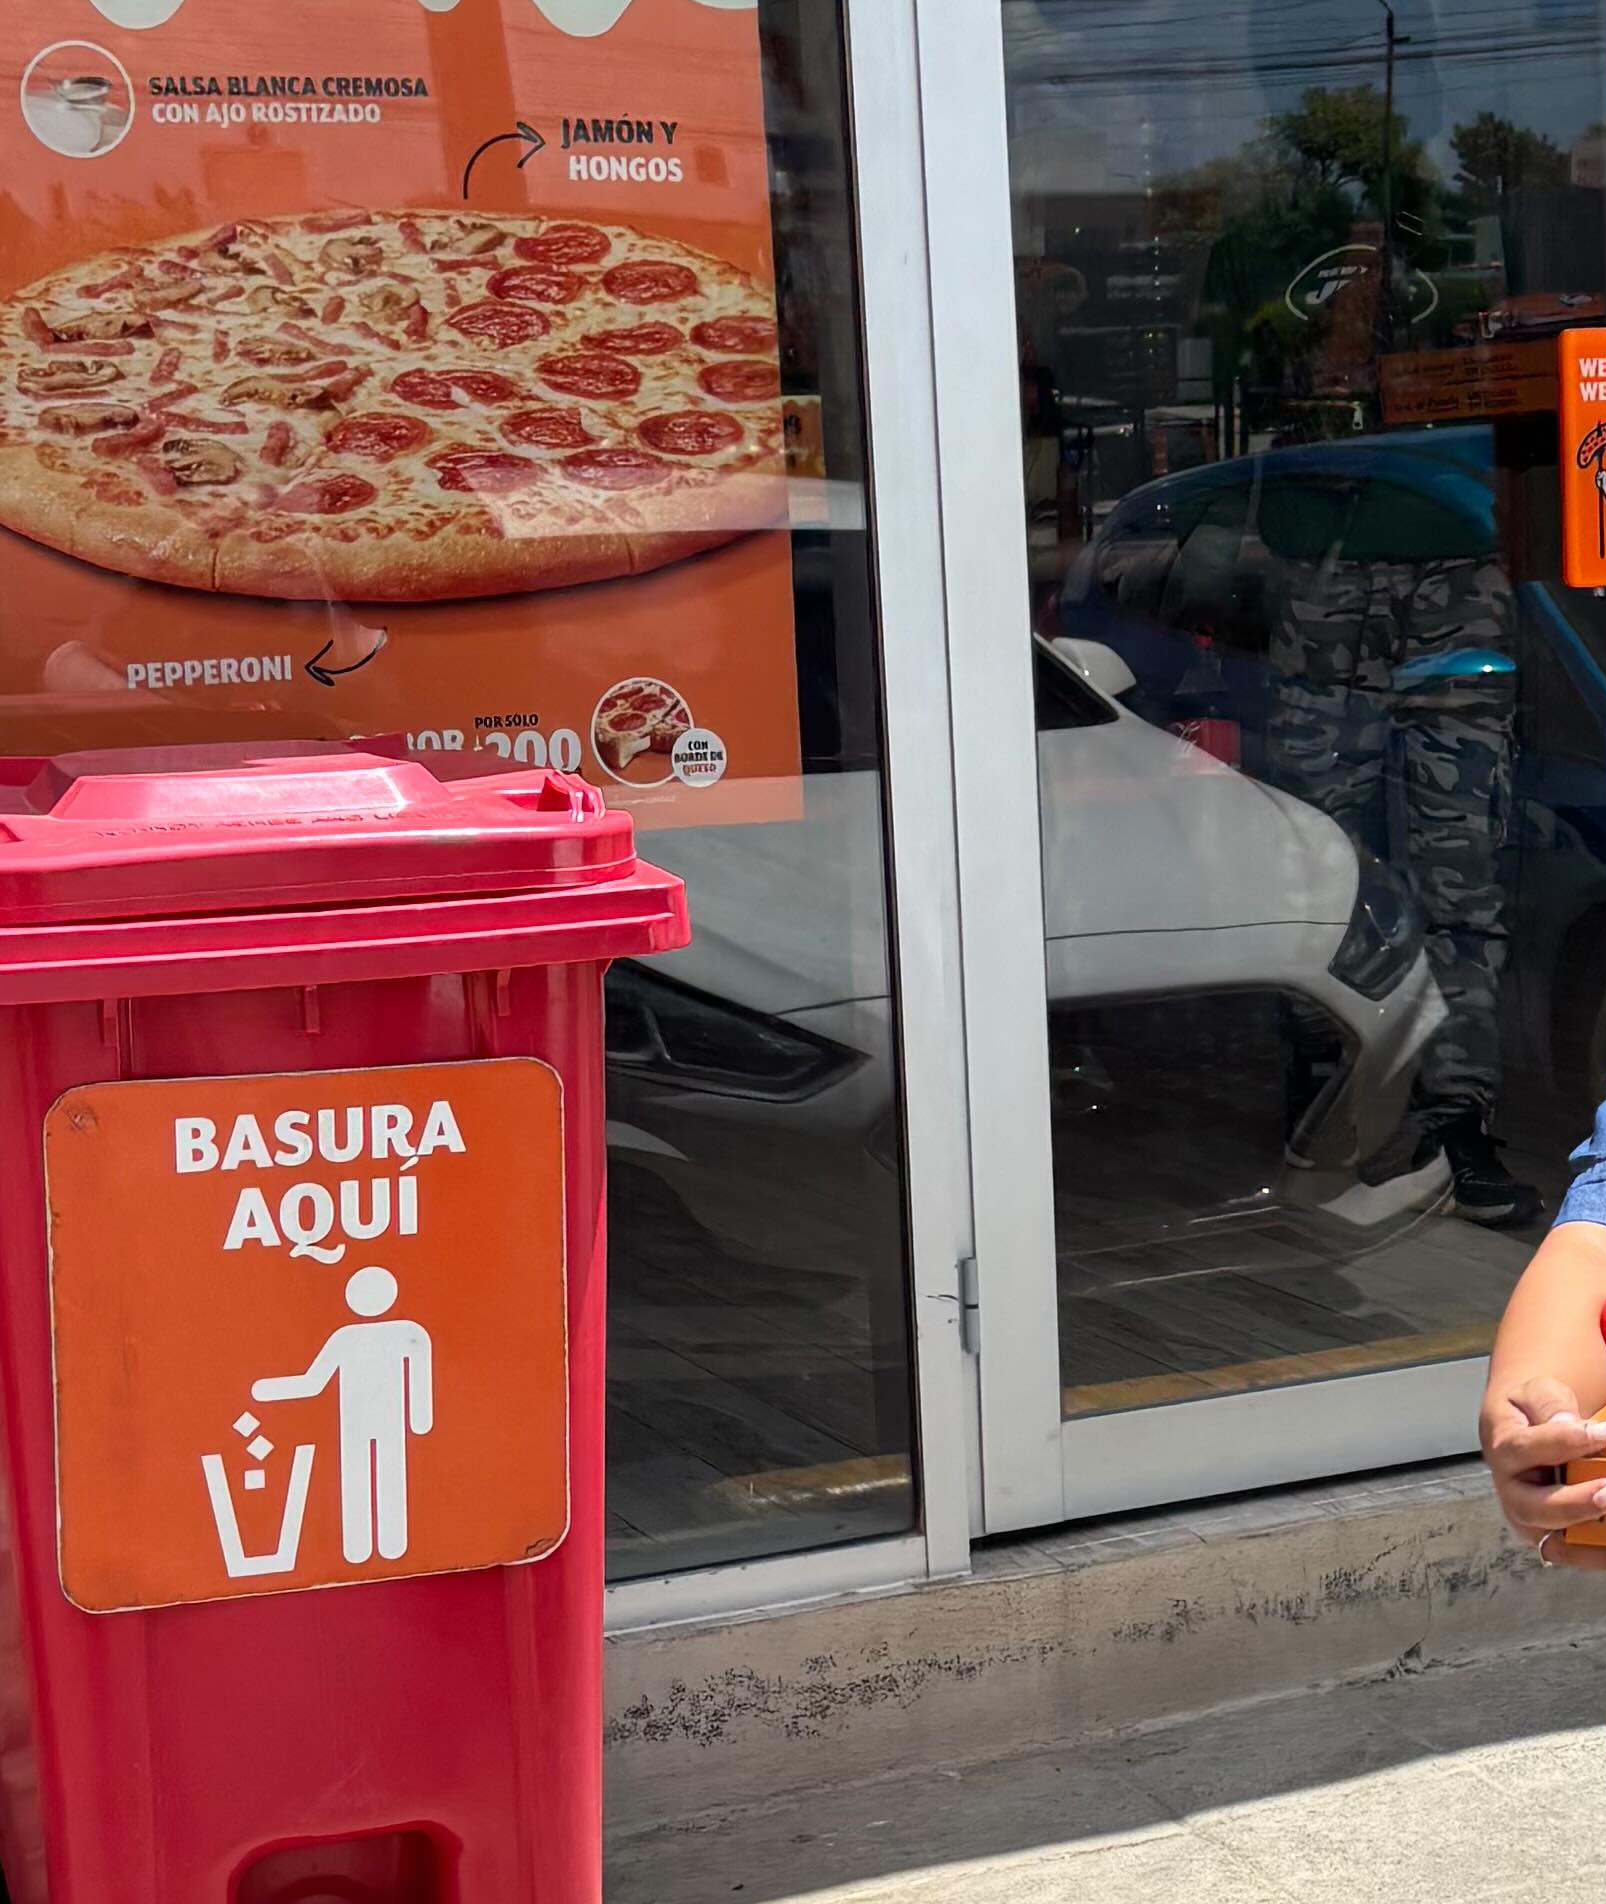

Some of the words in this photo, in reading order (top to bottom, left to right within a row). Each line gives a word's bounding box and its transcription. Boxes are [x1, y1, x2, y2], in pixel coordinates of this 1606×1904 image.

[149, 76, 221, 96] SALSA
[227, 77, 317, 97] BLANCA
[322, 77, 429, 98] CREMOSA
[152, 104, 199, 124] CON
[206, 104, 246, 128] AJO
[252, 104, 381, 124] ROSTIZADO
[561, 113, 654, 149] JAMÓN
[658, 121, 678, 145] Y
[569, 155, 683, 183] HONGOS
[127, 655, 292, 689] PEPPERONI
[474, 715, 503, 729] POR
[474, 728, 582, 772] 200
[688, 740, 708, 751] CON
[175, 1100, 466, 1174] BASURA
[223, 1155, 418, 1264] AQUÍ
